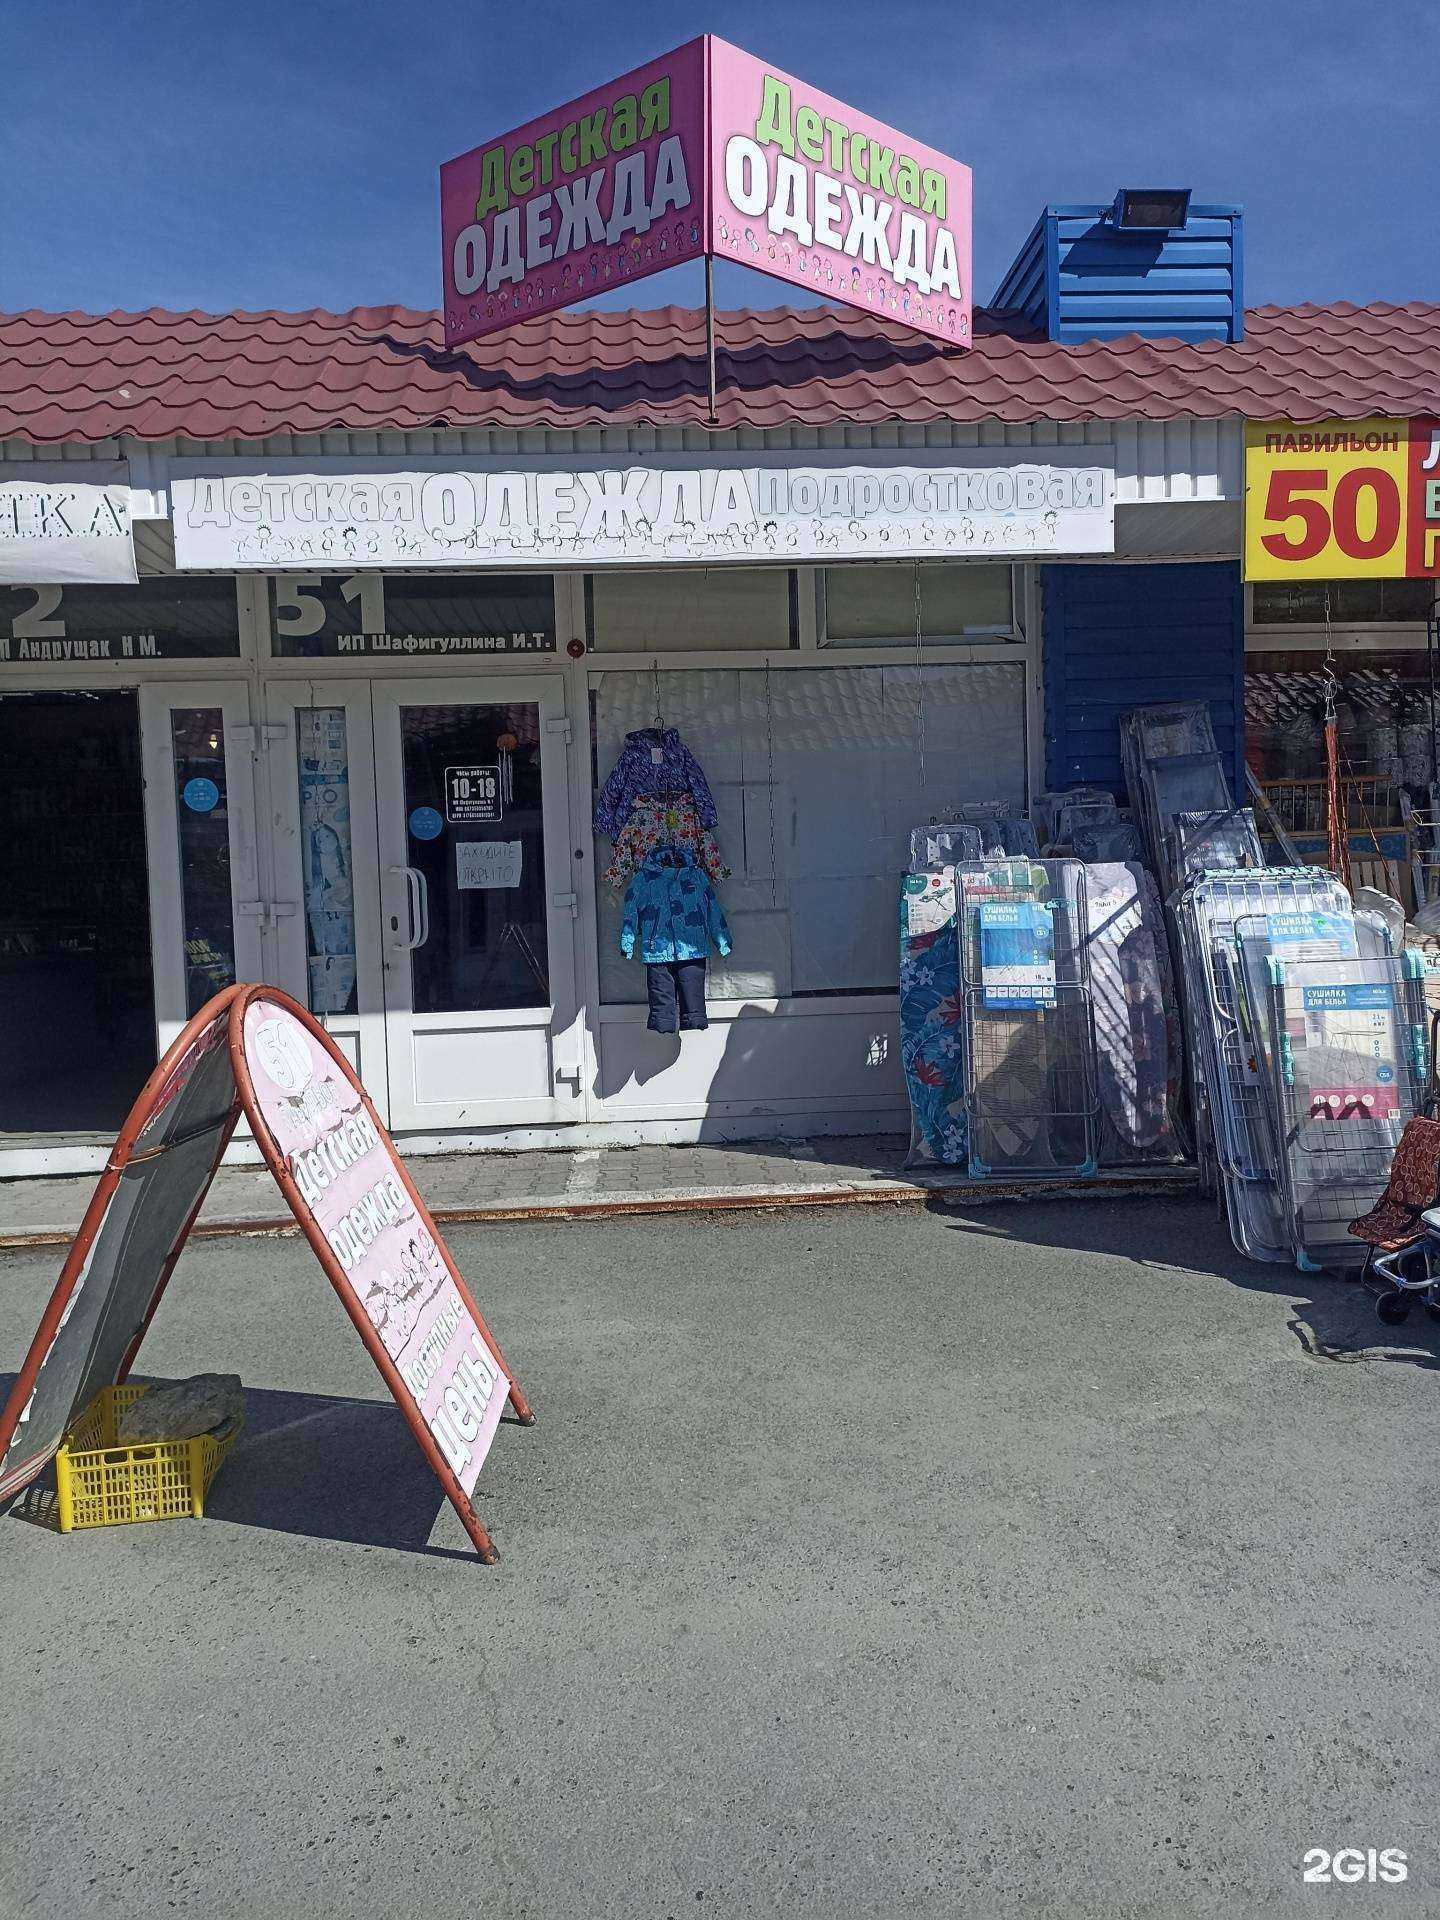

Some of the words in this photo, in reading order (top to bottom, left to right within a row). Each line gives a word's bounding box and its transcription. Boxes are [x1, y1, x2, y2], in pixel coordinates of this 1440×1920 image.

[475, 75, 671, 221] Детская
[756, 74, 947, 220] Детская
[453, 134, 691, 296] ОДЕЖДА
[724, 134, 962, 299] ОДЕЖДА
[1265, 432, 1399, 453] ПАВИЛЬОН
[188, 474, 415, 528] Детская
[421, 469, 758, 548] ОДЕЖДА
[758, 468, 1104, 519] Подростковая
[1261, 467, 1401, 561] 50
[11, 584, 66, 638] 2
[275, 575, 387, 637] 51
[338, 634, 366, 651] ИП
[372, 633, 506, 653] Шафигуллина
[512, 632, 551, 649] И.Т.
[19, 637, 111, 661] Андрущак
[451, 777, 496, 799] 10-18
[1307, 989, 1346, 998] СУШИЛКА
[289, 1111, 379, 1210] Детская
[328, 1172, 407, 1271] одежда
